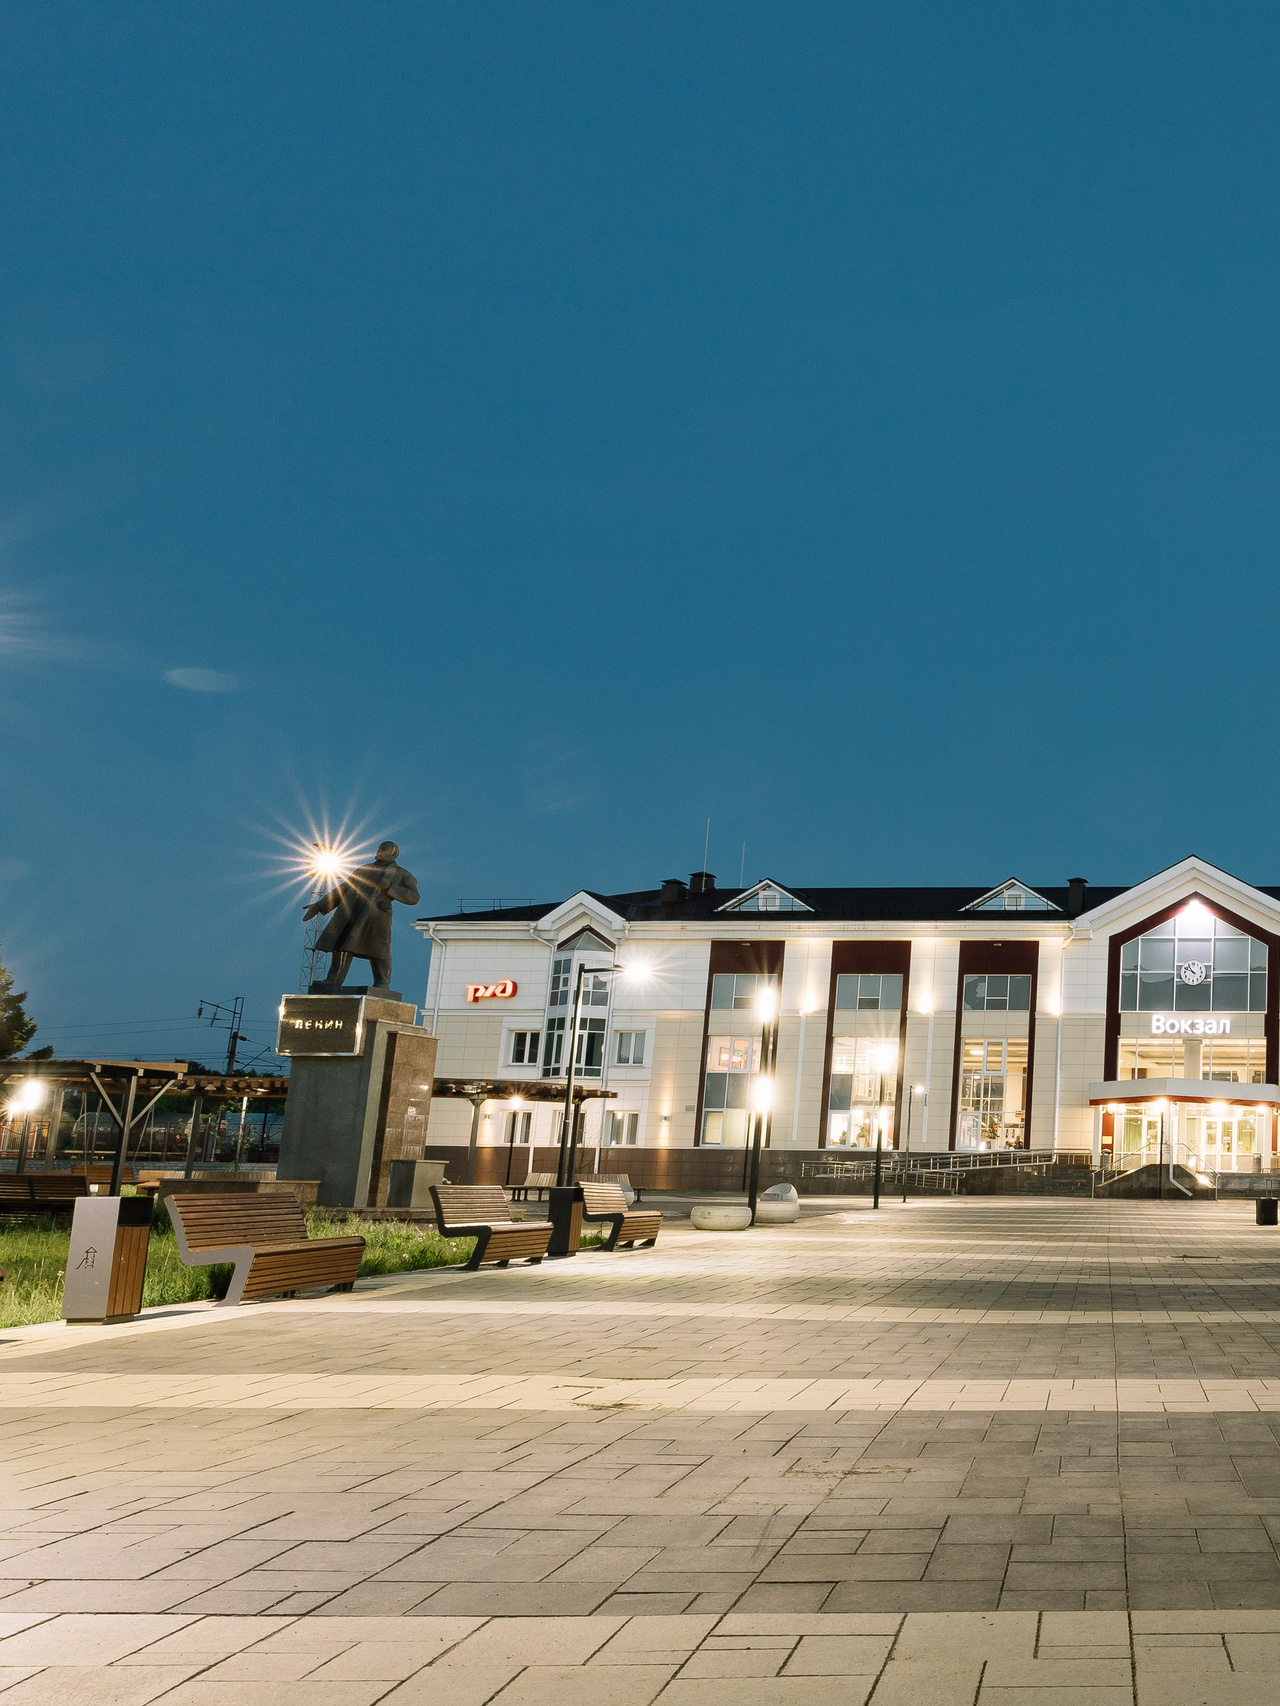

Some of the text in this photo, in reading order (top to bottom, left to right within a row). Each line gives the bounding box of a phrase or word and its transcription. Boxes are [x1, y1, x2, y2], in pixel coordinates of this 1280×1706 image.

[466, 979, 517, 1002] РЖД
[295, 1020, 343, 1029] ЛЕНИН
[1151, 1014, 1231, 1034] Вокзал
